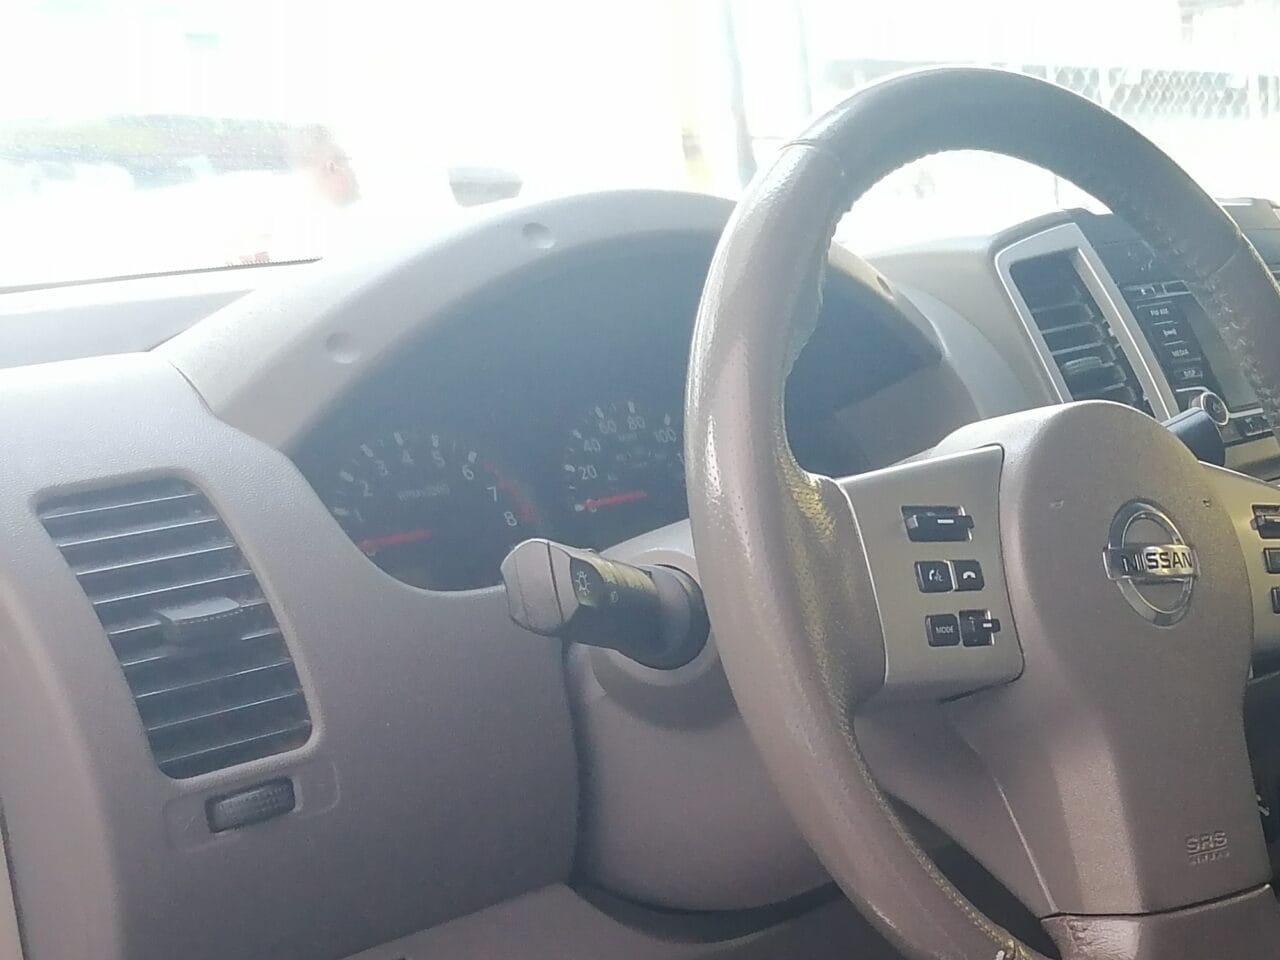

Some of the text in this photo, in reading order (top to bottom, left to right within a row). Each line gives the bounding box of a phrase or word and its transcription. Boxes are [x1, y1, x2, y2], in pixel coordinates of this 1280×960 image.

[626, 416, 645, 430] 80
[654, 428, 677, 443] 100
[462, 464, 474, 480] 6
[578, 465, 598, 480] 20
[486, 486, 498, 502] 7
[503, 511, 518, 527] 8
[1121, 550, 1193, 573] NISSAN
